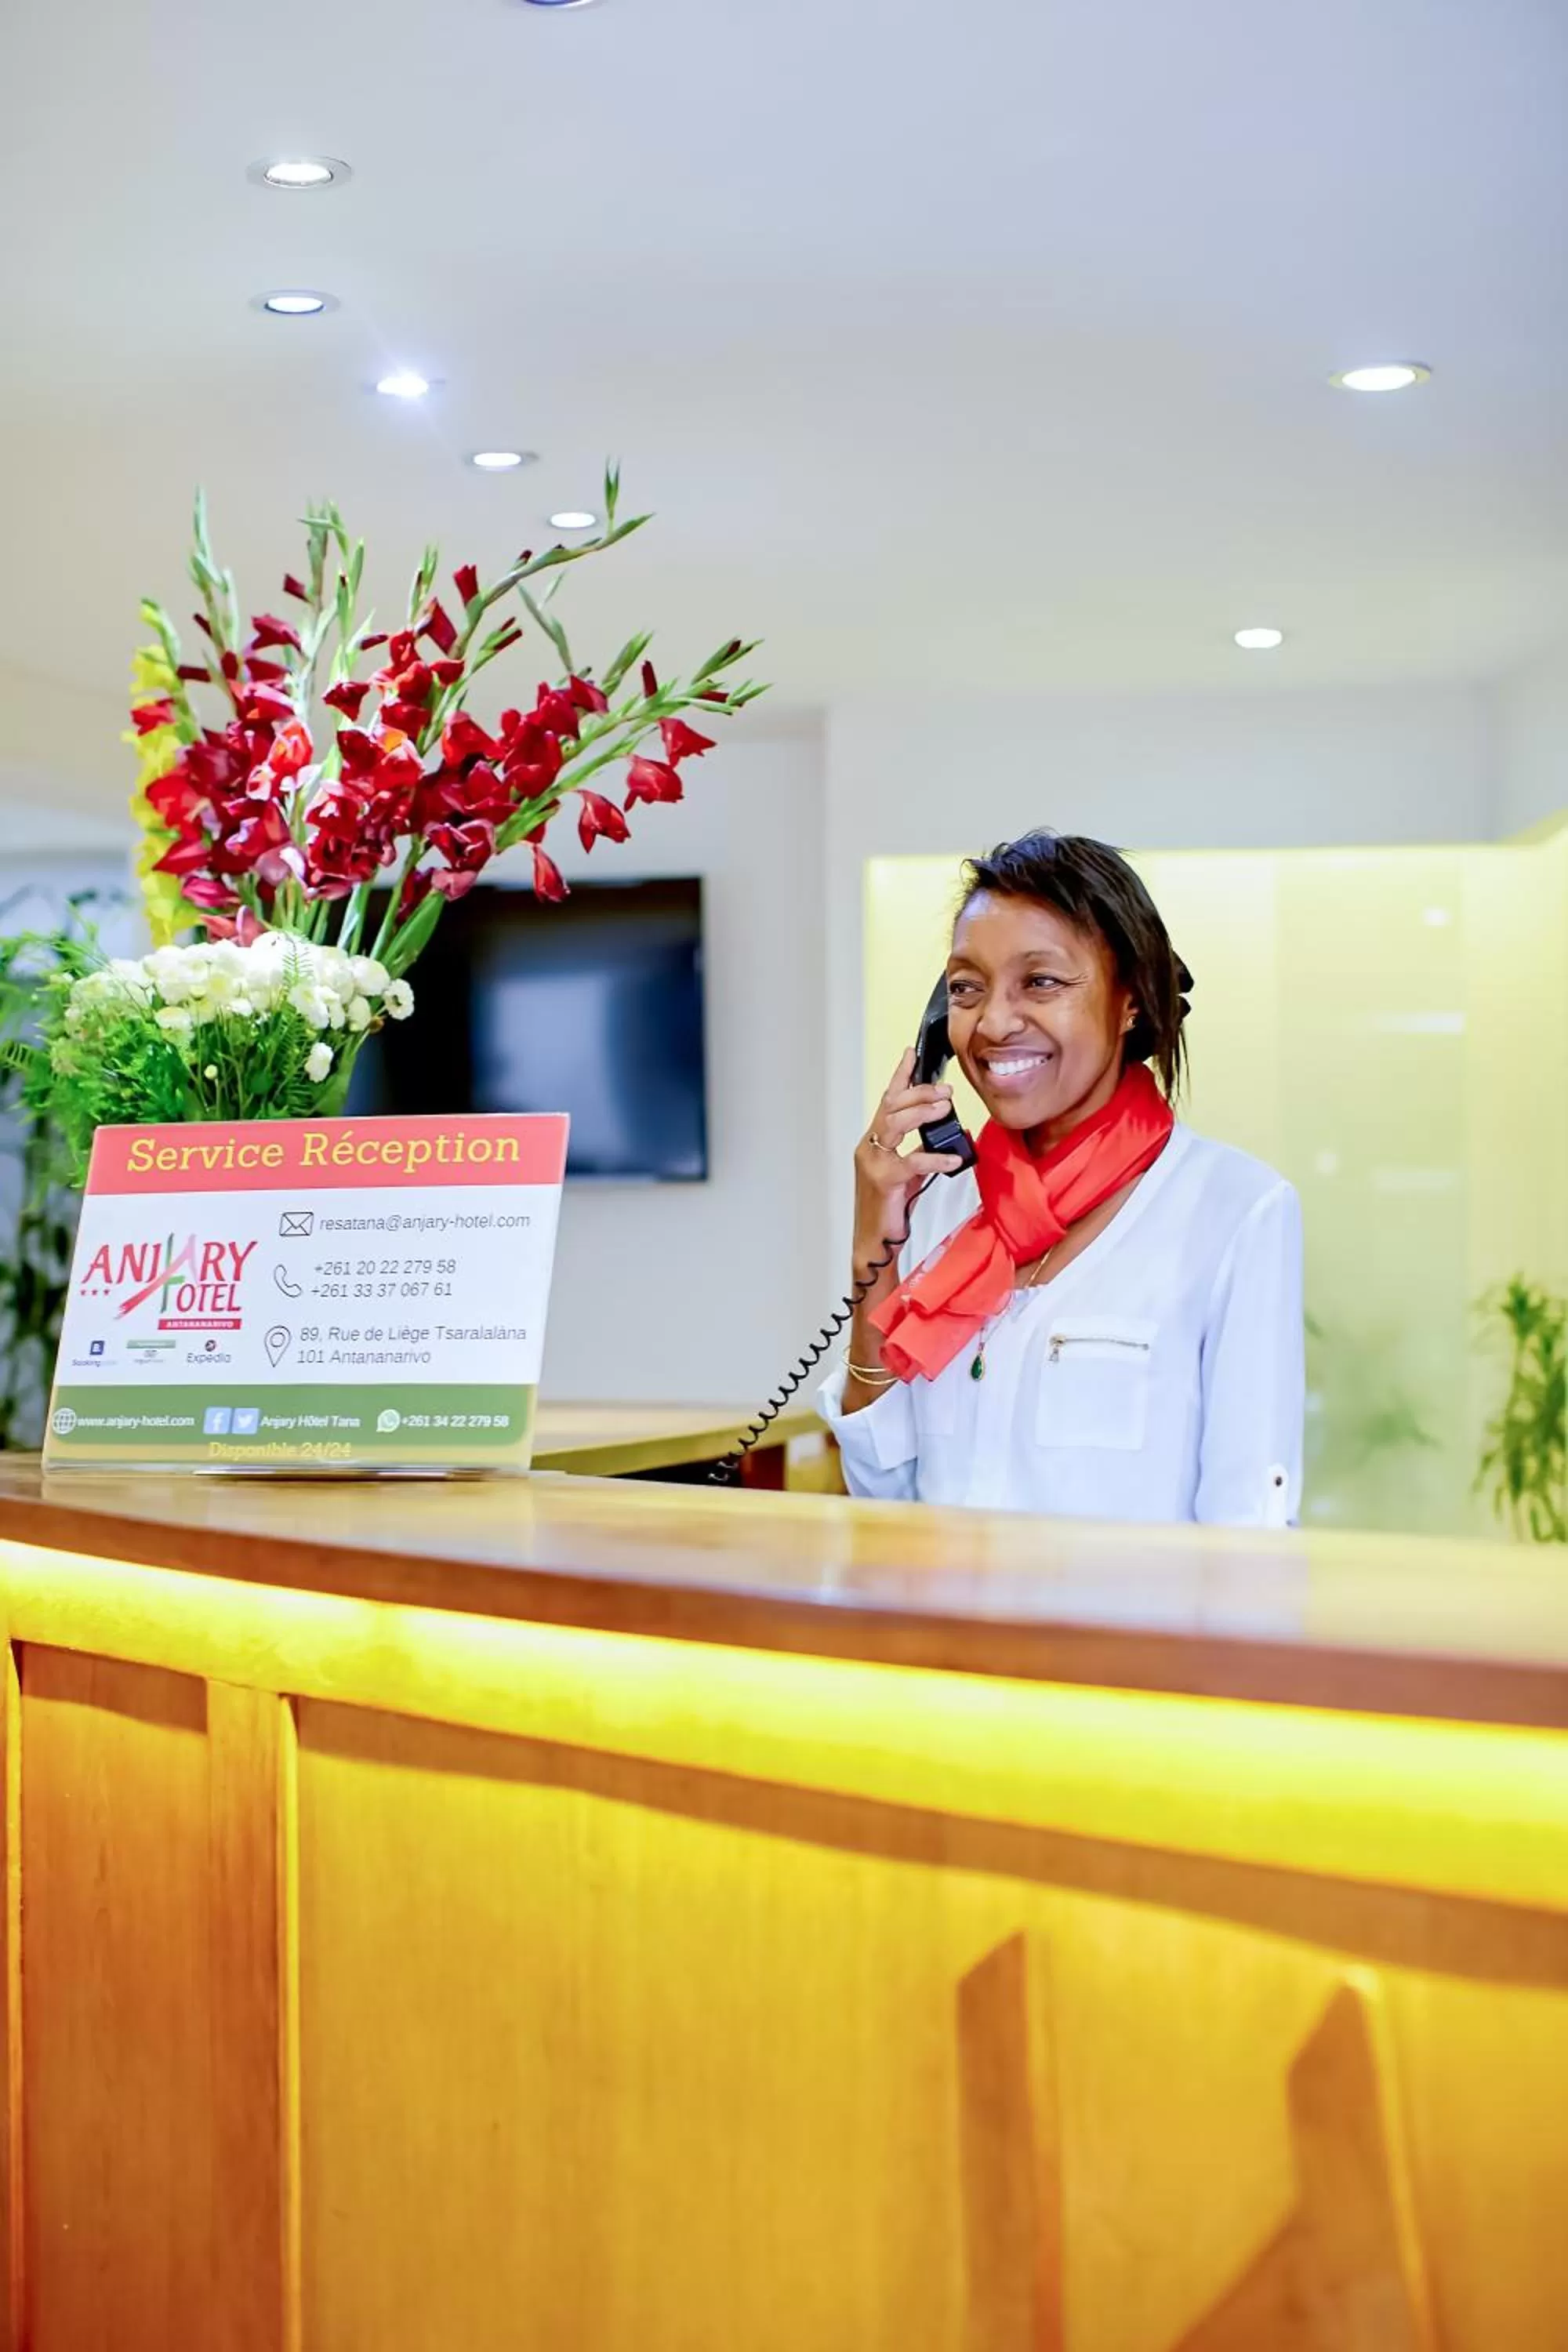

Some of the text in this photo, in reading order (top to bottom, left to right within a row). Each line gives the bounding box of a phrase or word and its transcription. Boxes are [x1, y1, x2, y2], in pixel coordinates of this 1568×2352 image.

[127, 1131, 521, 1174] Service Réception
[319, 1214, 530, 1232] resatana@anjary-hotel.com
[82, 1233, 257, 1287] ANJARY
[314, 1259, 456, 1276] +261 20 22 279 58
[310, 1283, 452, 1298] +261 33 37 067 61
[328, 1327, 360, 1341] Rue
[365, 1327, 383, 1341] de
[187, 1352, 232, 1364] Expedia
[297, 1349, 430, 1364] 101 Antananarivo
[77, 1415, 195, 1429] www.anjary-hotel.com
[260, 1415, 296, 1429] Anjary
[332, 1416, 361, 1428] Tana
[401, 1414, 510, 1428] +261 34 22 279 58
[209, 1441, 352, 1461] Disponible 24/24
